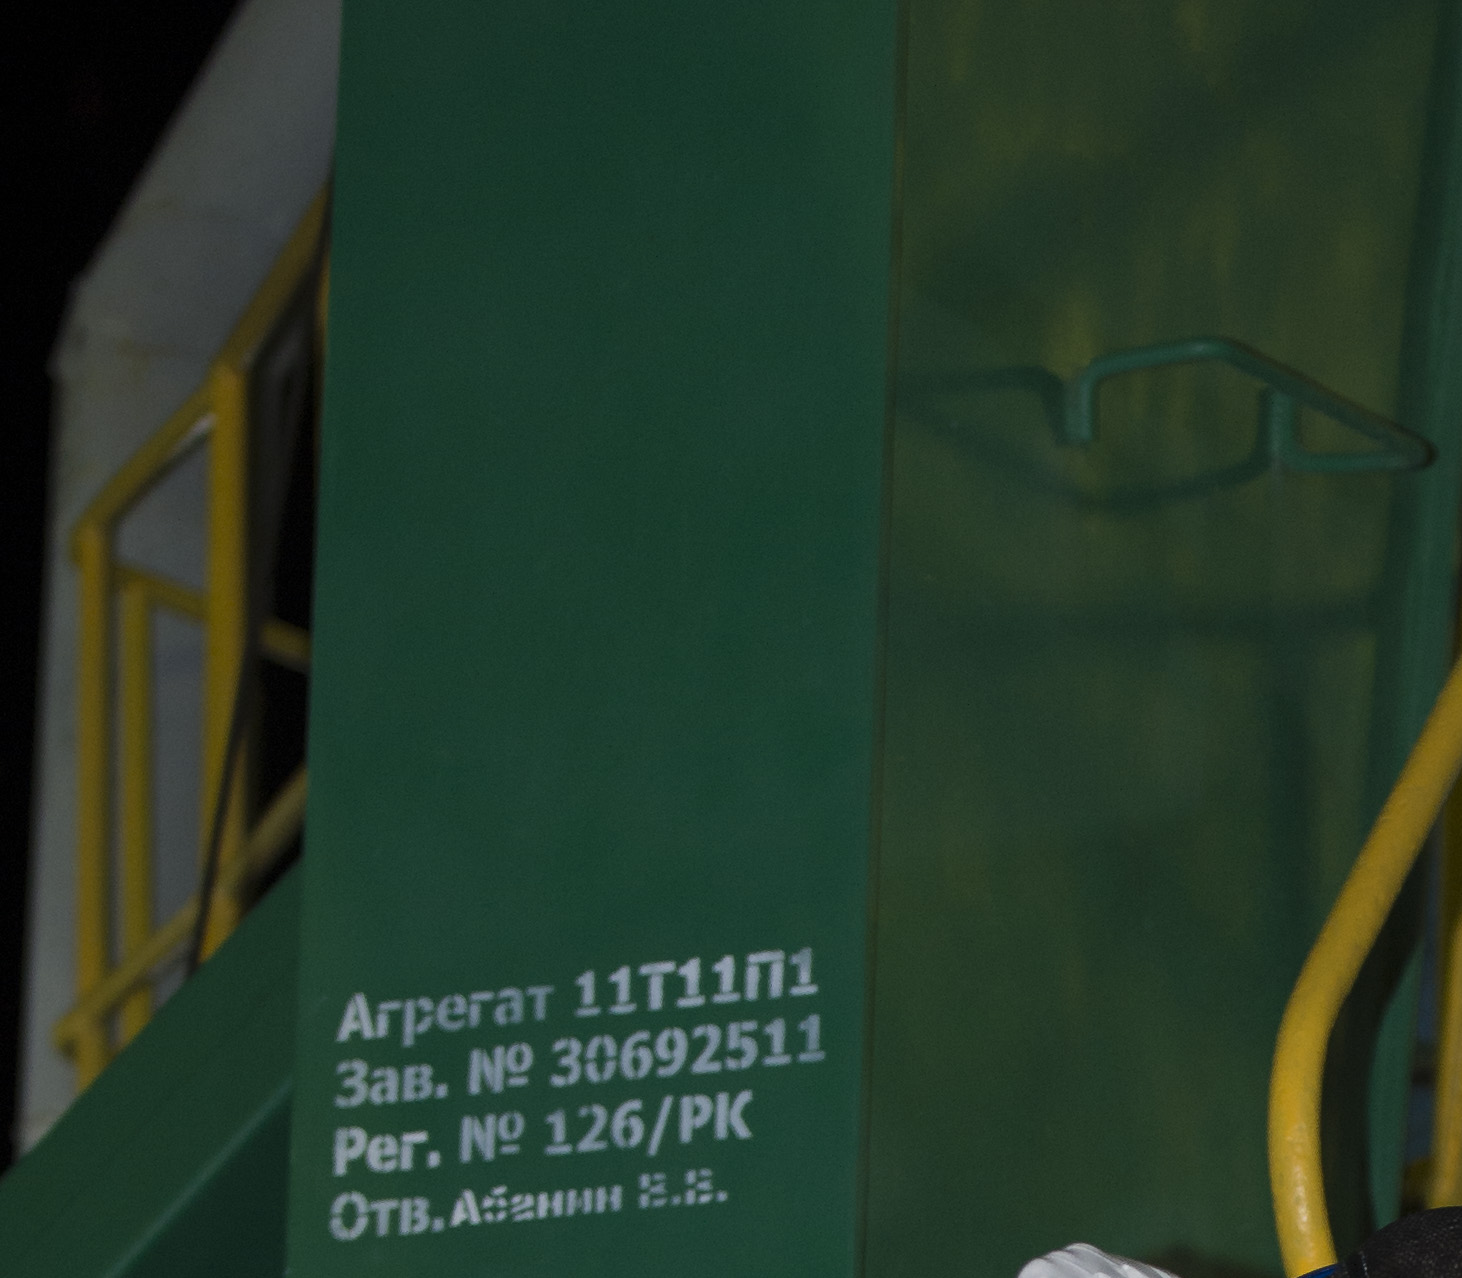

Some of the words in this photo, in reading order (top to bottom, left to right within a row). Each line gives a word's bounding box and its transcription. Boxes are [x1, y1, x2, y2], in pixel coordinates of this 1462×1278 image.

[334, 983, 556, 1047] Агрегат
[333, 1059, 450, 1109] Зав.
[548, 1013, 826, 1089] 30692511
[332, 1126, 442, 1178] Рег.
[543, 1089, 754, 1157] 126/РК
